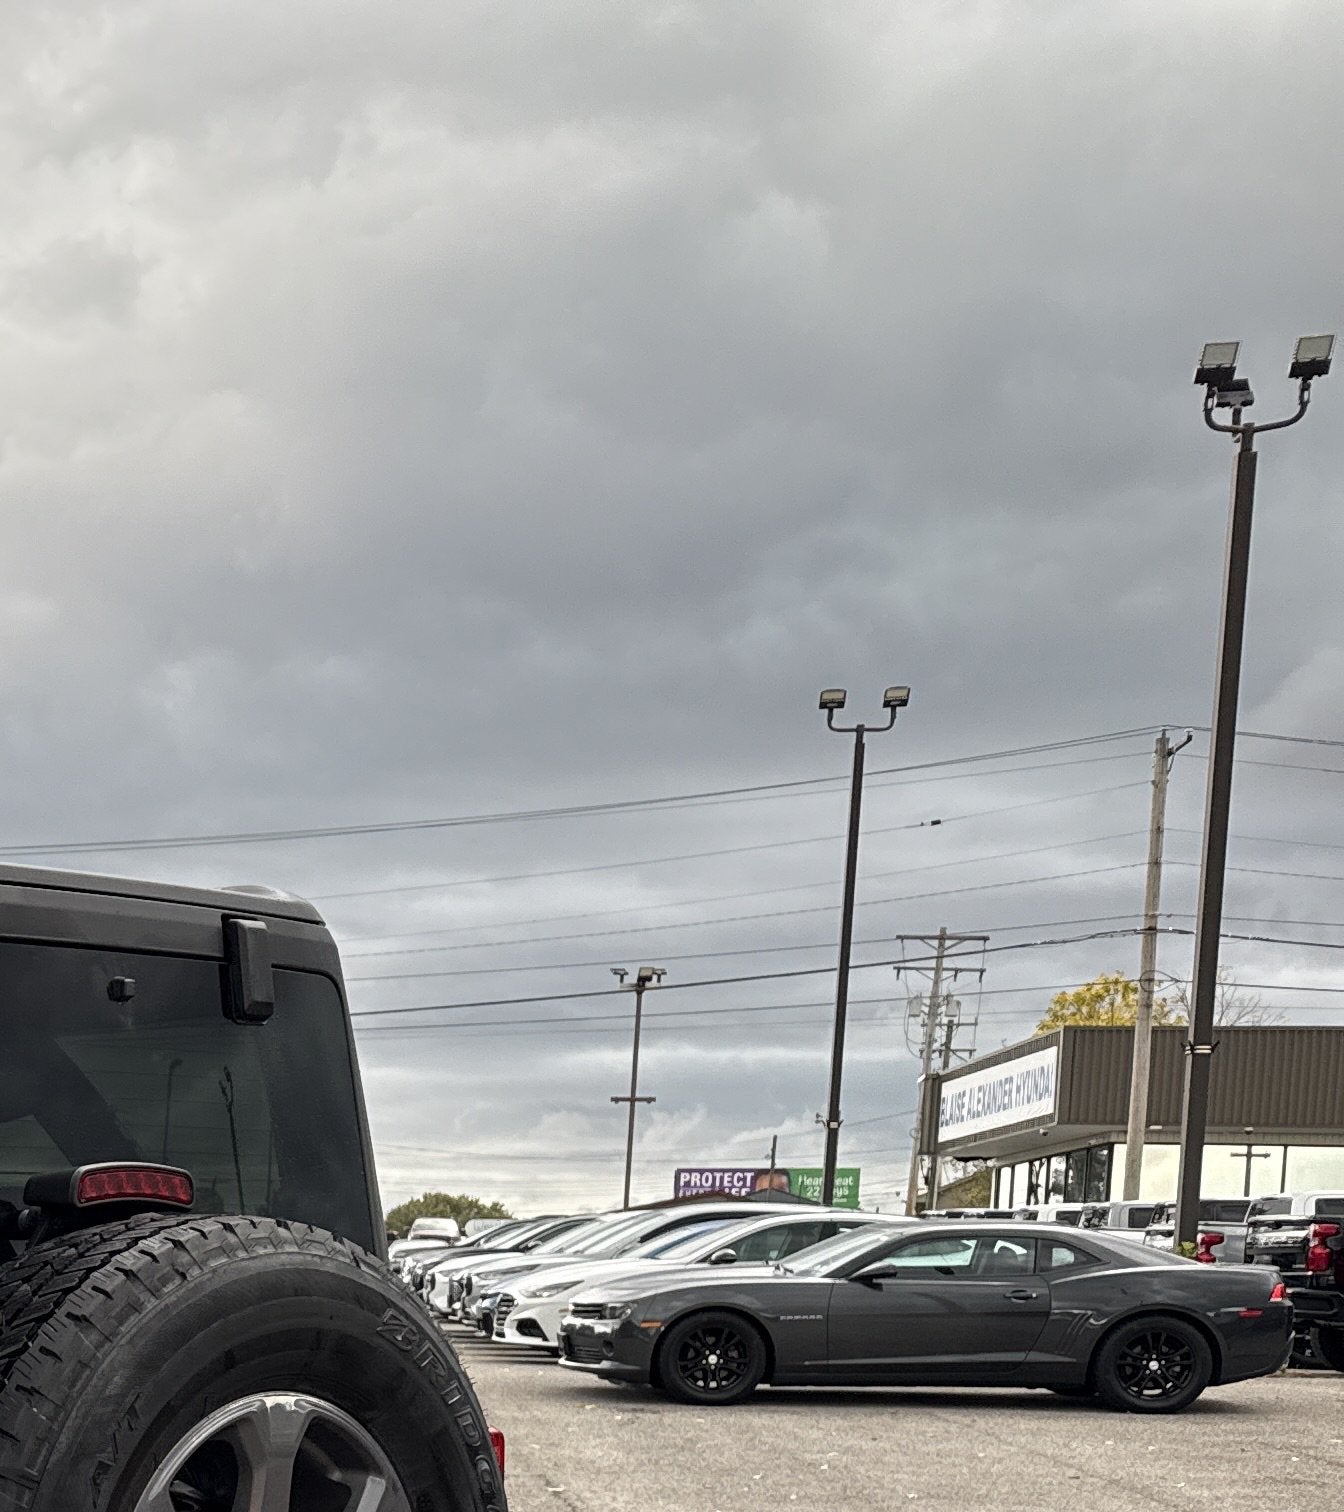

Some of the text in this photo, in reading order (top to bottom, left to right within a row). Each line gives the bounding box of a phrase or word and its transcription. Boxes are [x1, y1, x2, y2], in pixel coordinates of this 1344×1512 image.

[940, 1063, 1054, 1128] BLAISE ALEXANDER HYUNDAI
[679, 1171, 755, 1187] PROTECT
